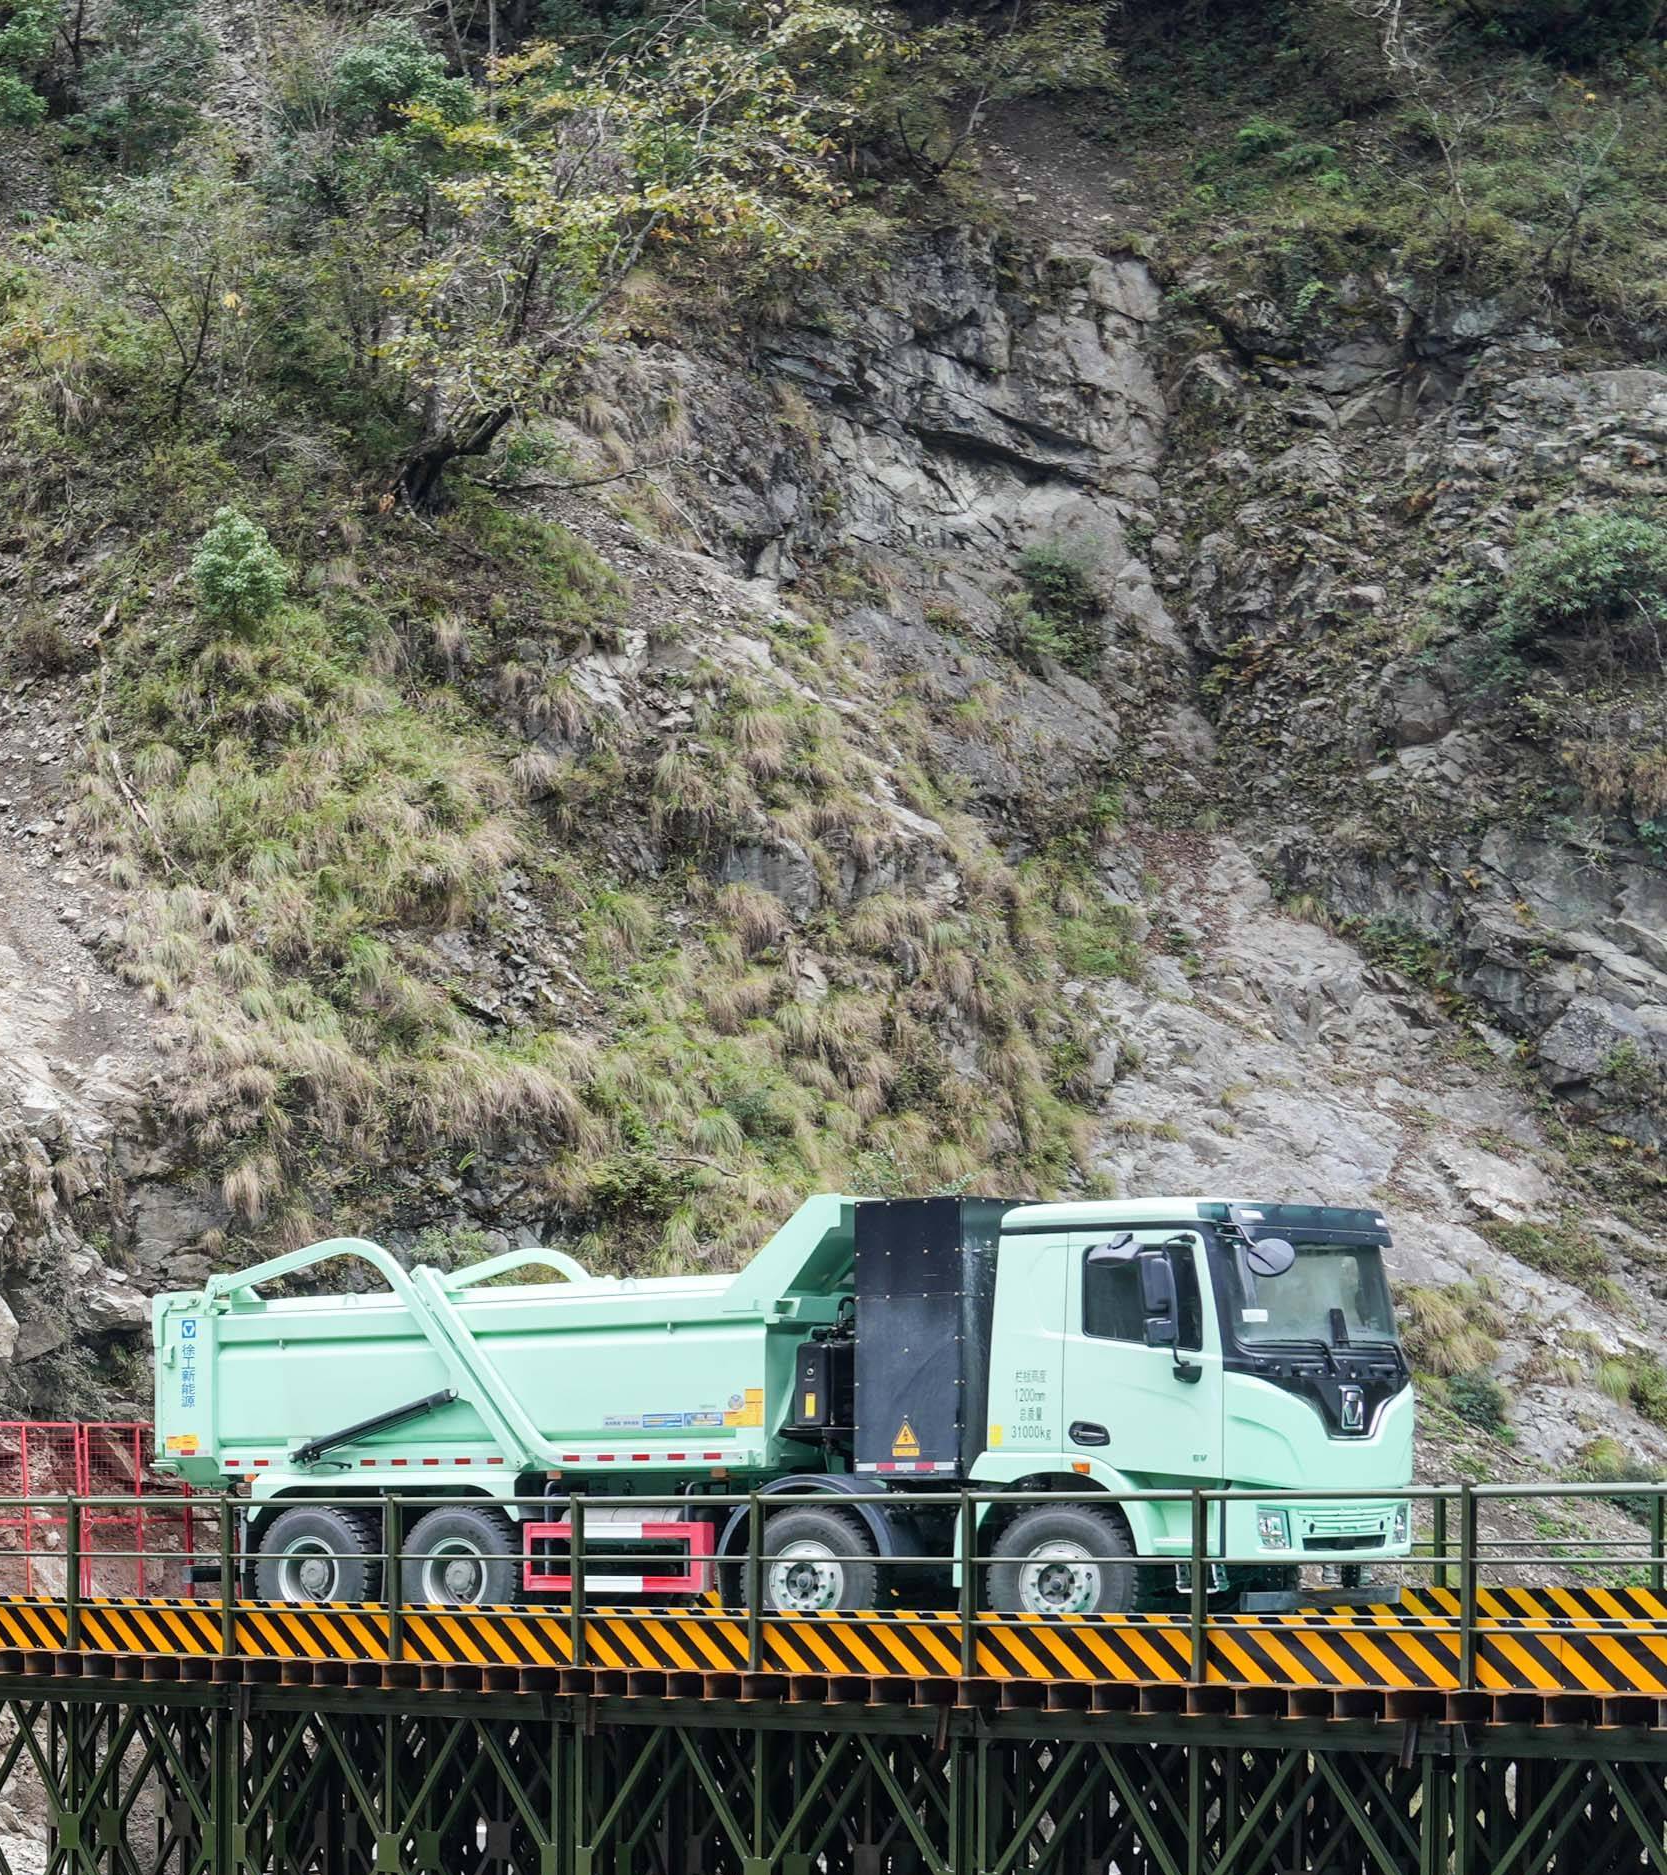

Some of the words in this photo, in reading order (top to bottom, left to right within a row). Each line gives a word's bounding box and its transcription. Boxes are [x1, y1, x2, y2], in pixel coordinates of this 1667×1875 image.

[181, 1344, 196, 1408] 徐工新能源
[1011, 1425, 1052, 1440] 31000kg
